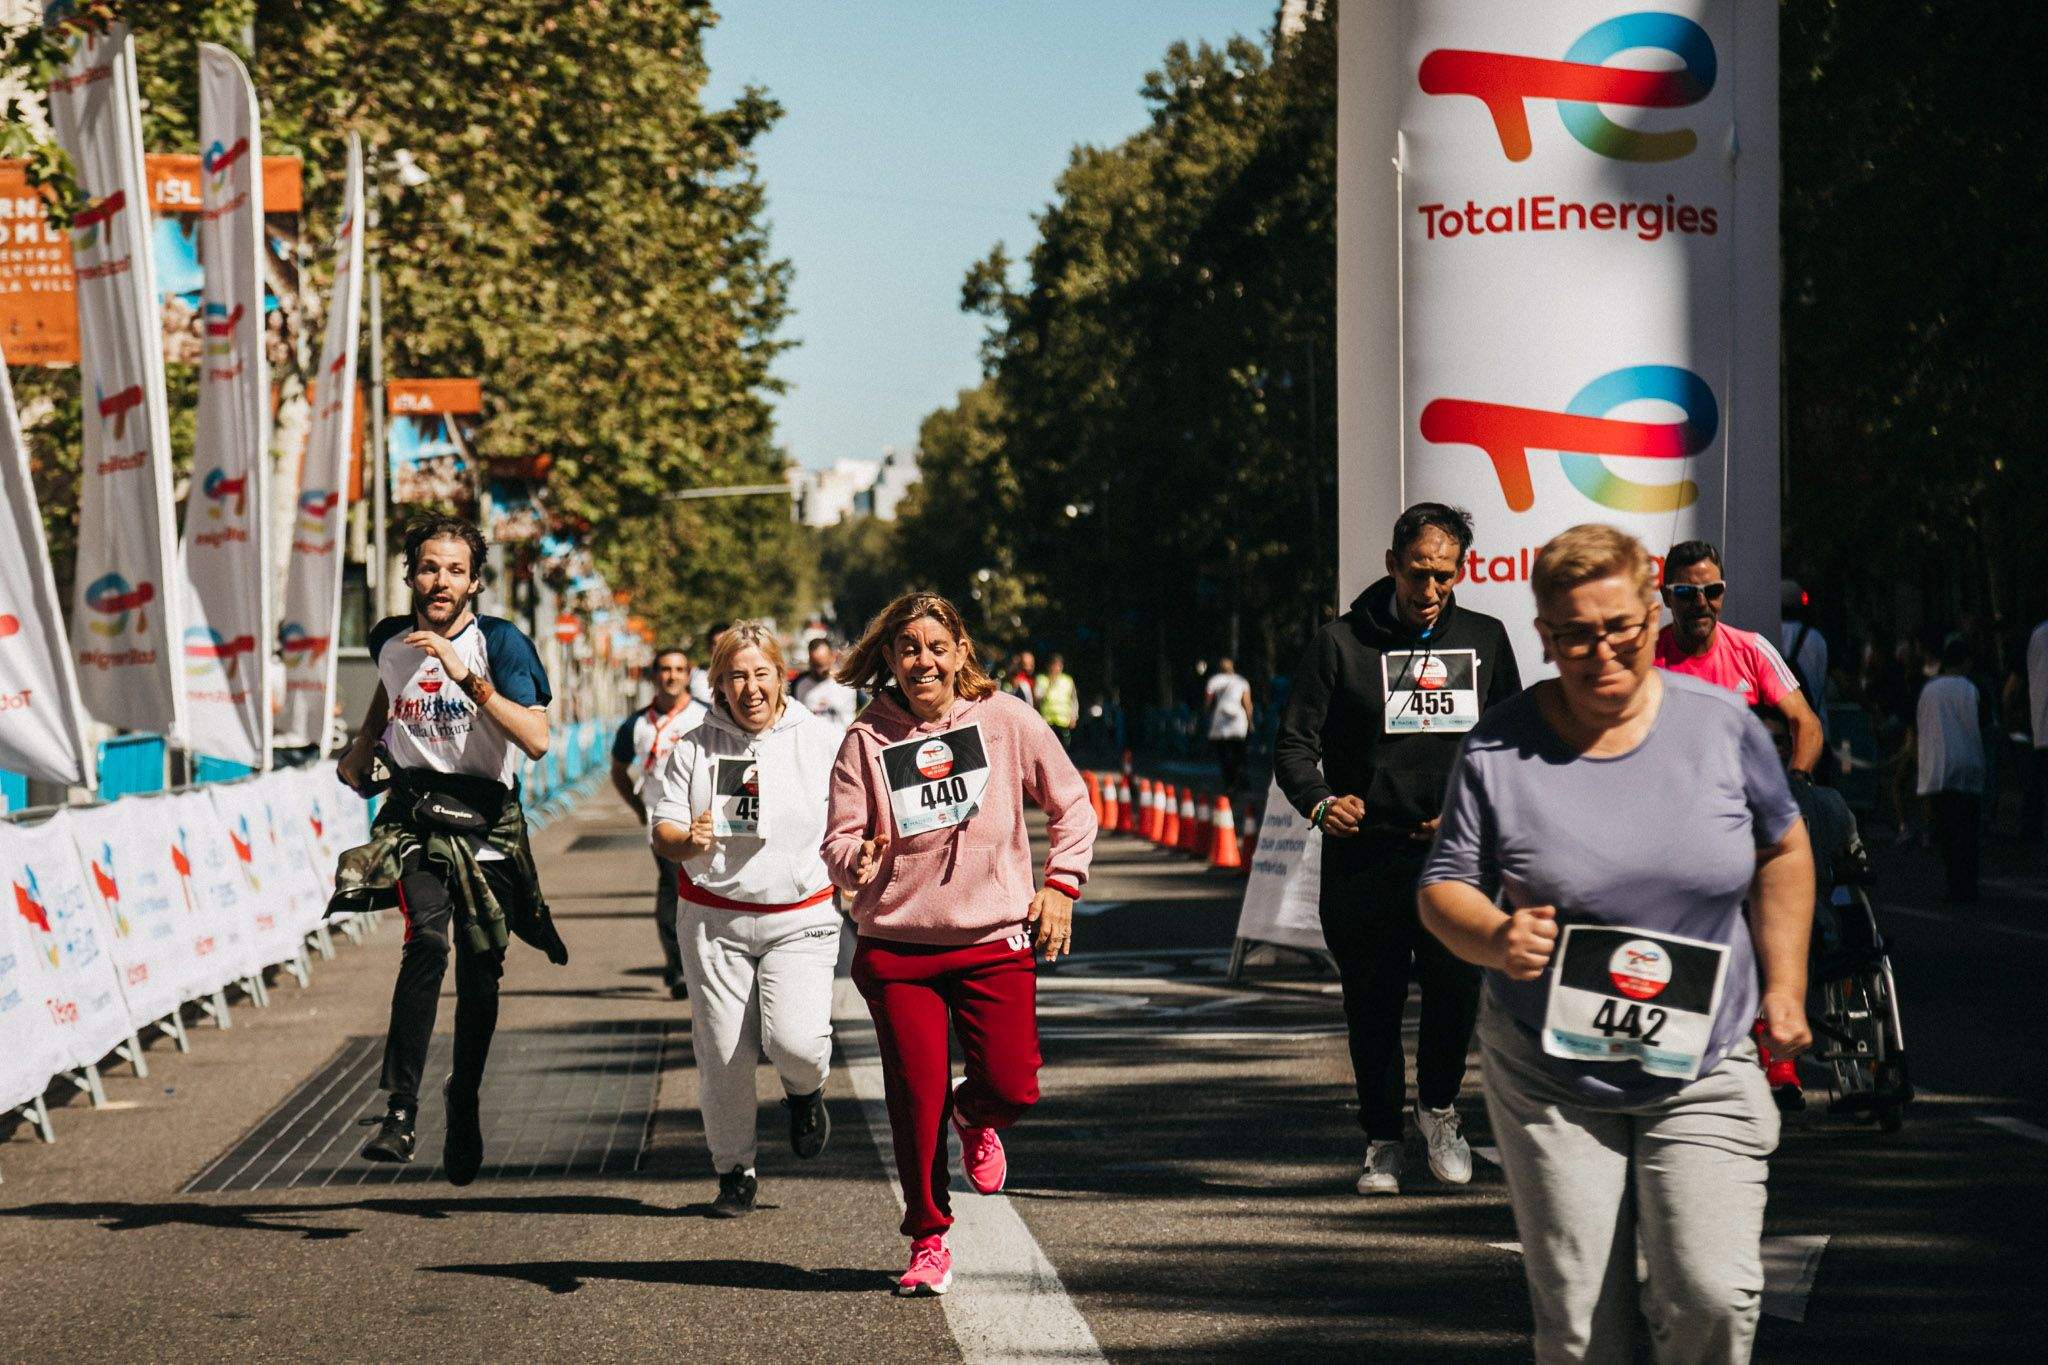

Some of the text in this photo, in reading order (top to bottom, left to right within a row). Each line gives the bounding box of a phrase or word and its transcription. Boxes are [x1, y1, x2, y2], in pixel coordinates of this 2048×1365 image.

[1417, 193, 1718, 241] TotalEnergies
[1411, 691, 1454, 715] 455
[920, 775, 969, 811] 440
[1592, 998, 1668, 1048] 442
